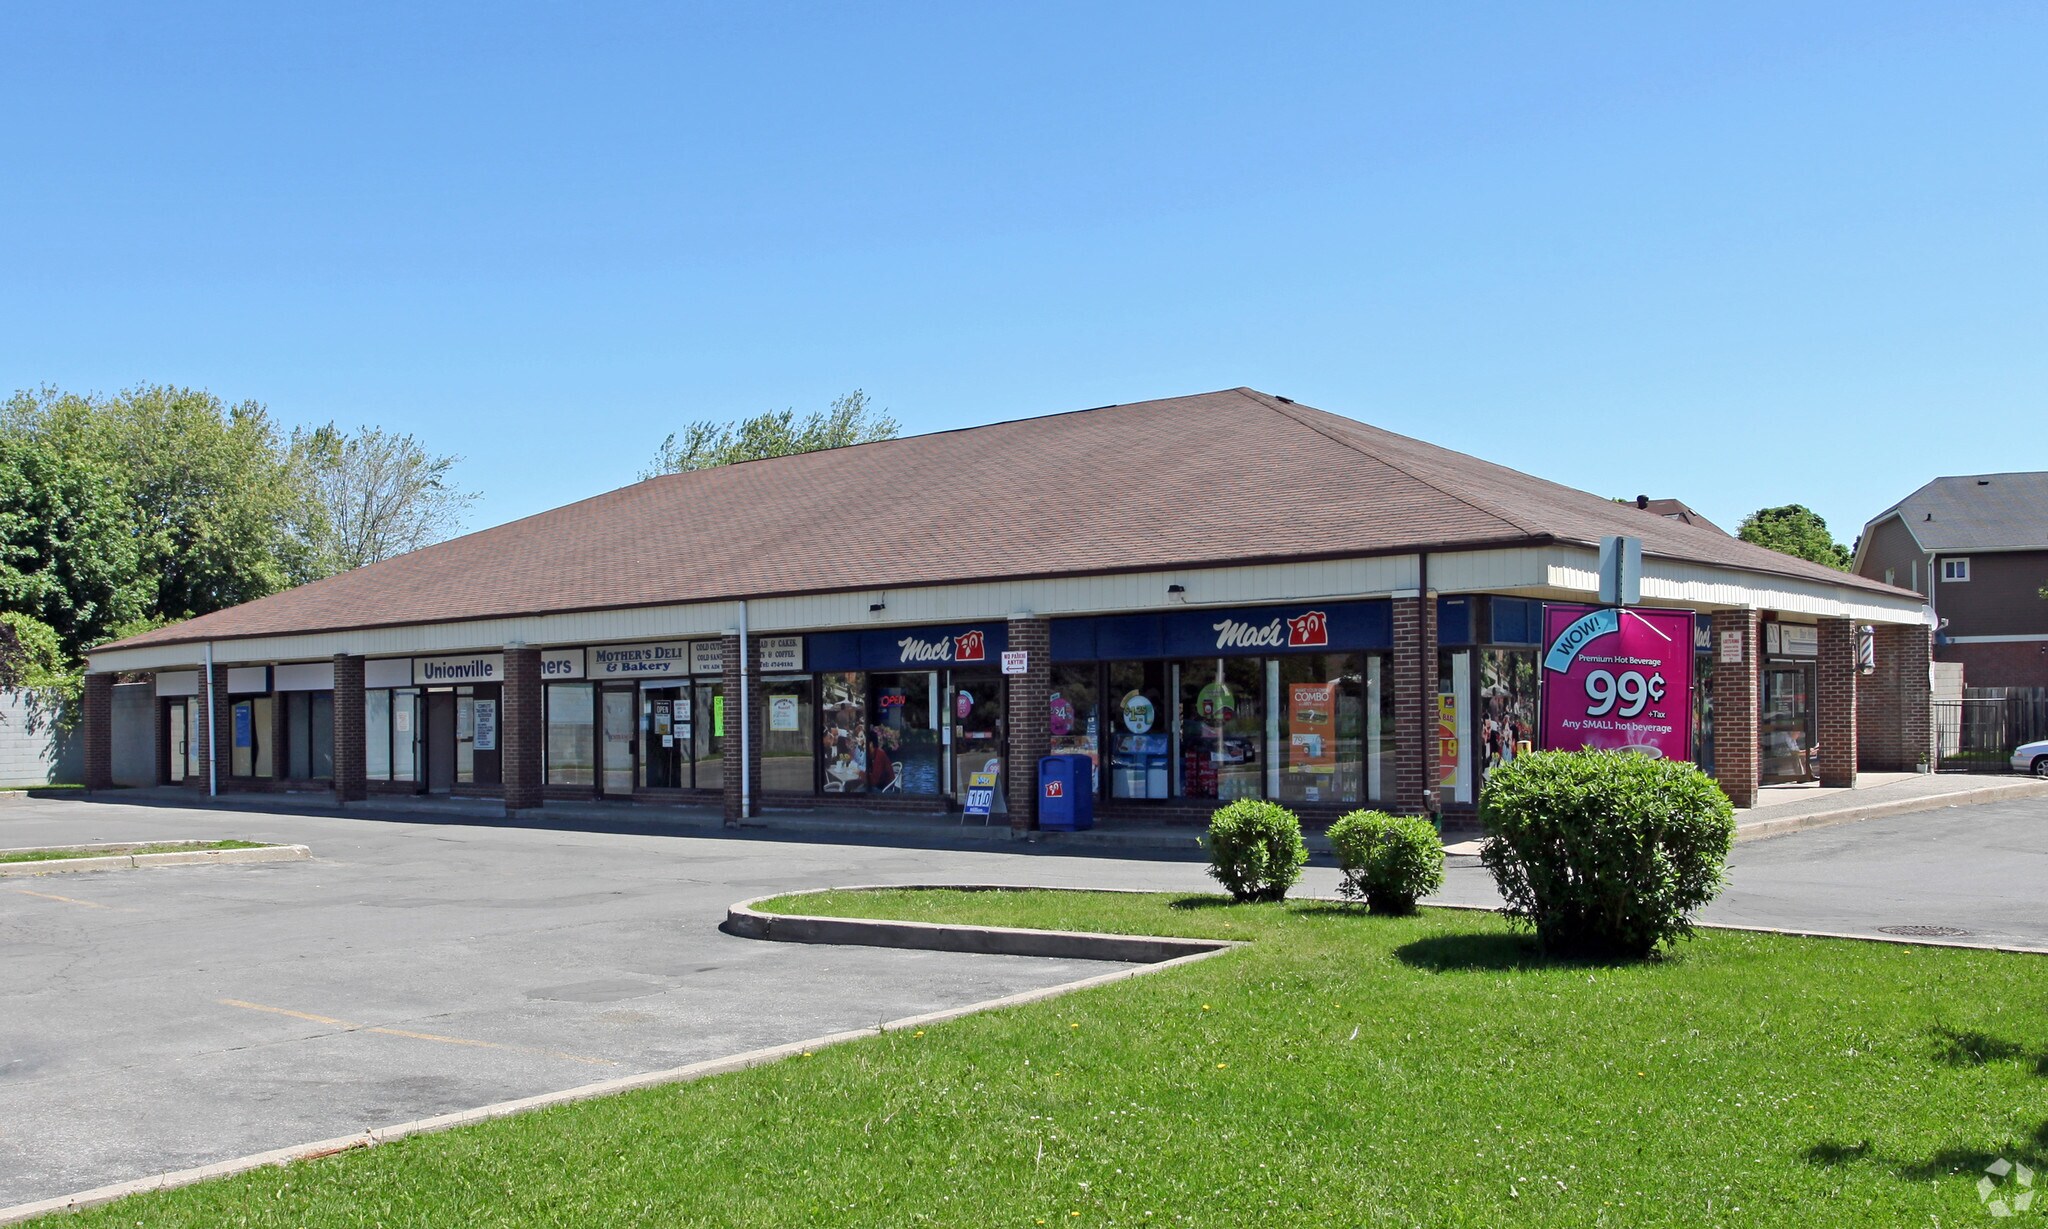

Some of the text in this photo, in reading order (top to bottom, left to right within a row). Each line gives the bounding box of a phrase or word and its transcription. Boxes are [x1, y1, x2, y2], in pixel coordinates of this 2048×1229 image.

[1213, 618, 1284, 649] Mac's
[1557, 617, 1600, 655] WOW!
[596, 647, 682, 662] MOTHER'S DELI
[898, 636, 952, 663] Mac's
[606, 662, 671, 672] & Bakery
[1579, 654, 1662, 667] Premium Hot Beverage
[424, 660, 493, 679] Unionville
[1294, 692, 1330, 701] COMBO
[1585, 669, 1666, 717] 99¢
[880, 695, 906, 707] OPEN
[656, 705, 669, 713] OPEN
[1562, 719, 1672, 733] Any SMALL hot beverage
